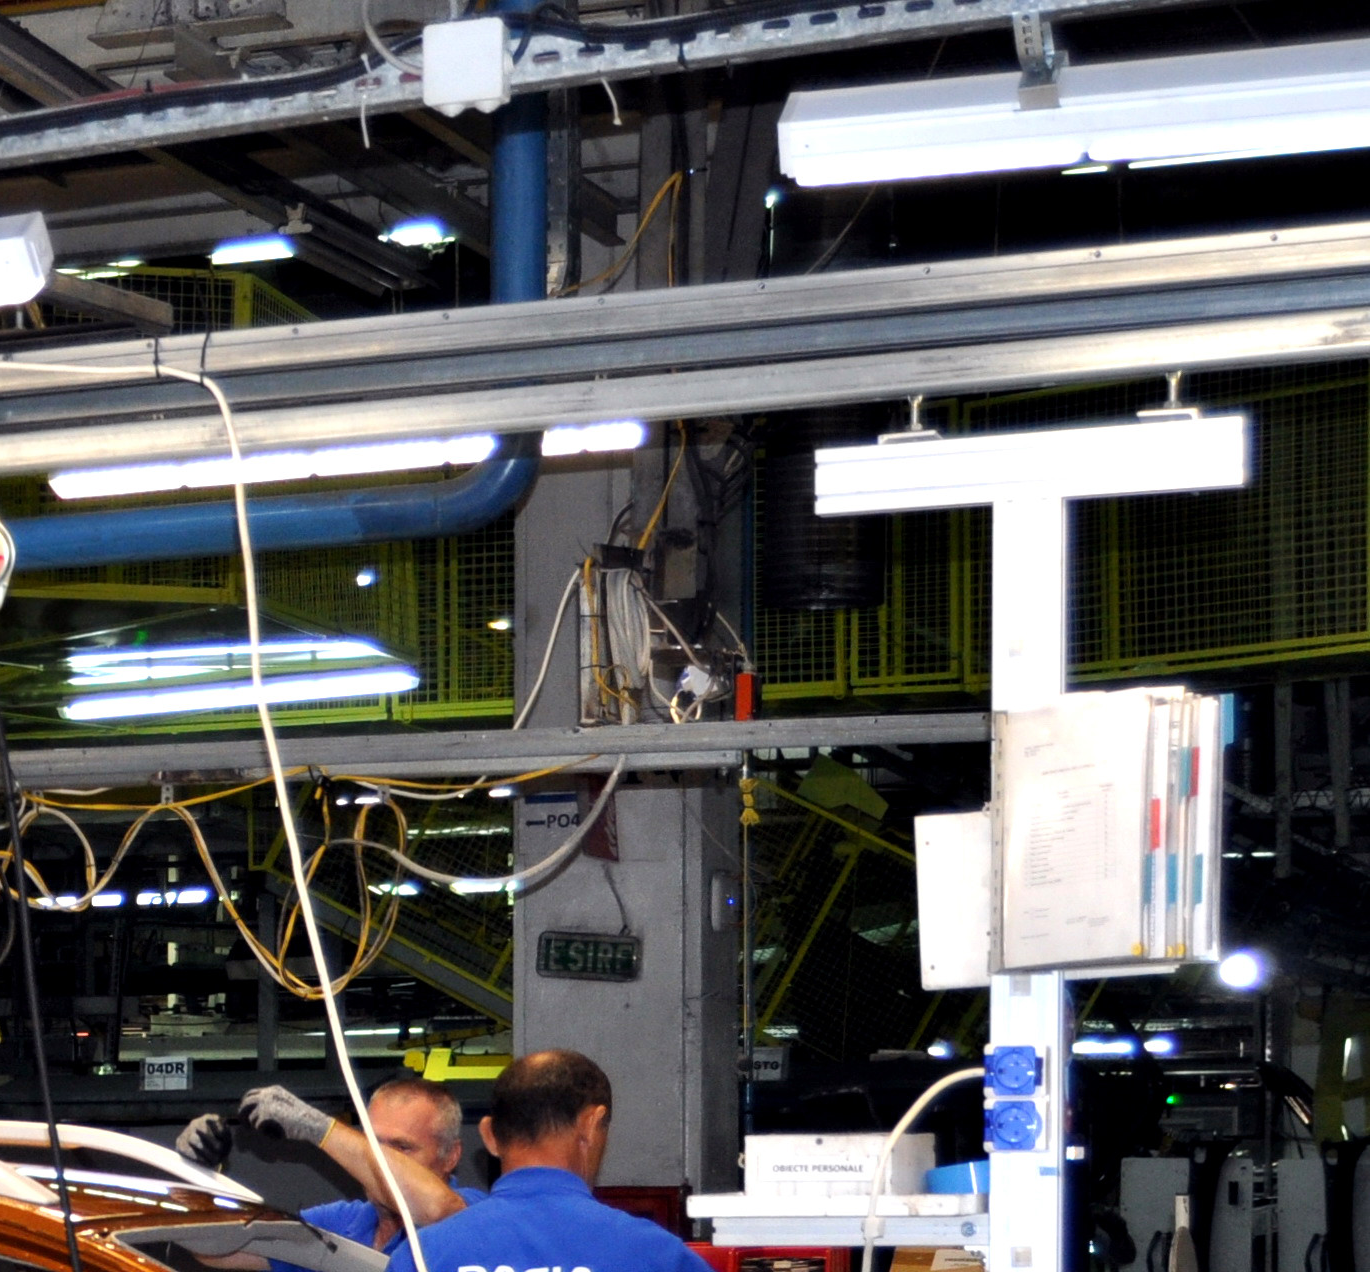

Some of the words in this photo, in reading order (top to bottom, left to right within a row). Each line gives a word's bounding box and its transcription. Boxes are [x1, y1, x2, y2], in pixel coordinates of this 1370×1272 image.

[147, 1062, 185, 1075] 04DR
[772, 1164, 808, 1173] OBIECTE
[811, 1164, 863, 1173] PERSONALE
